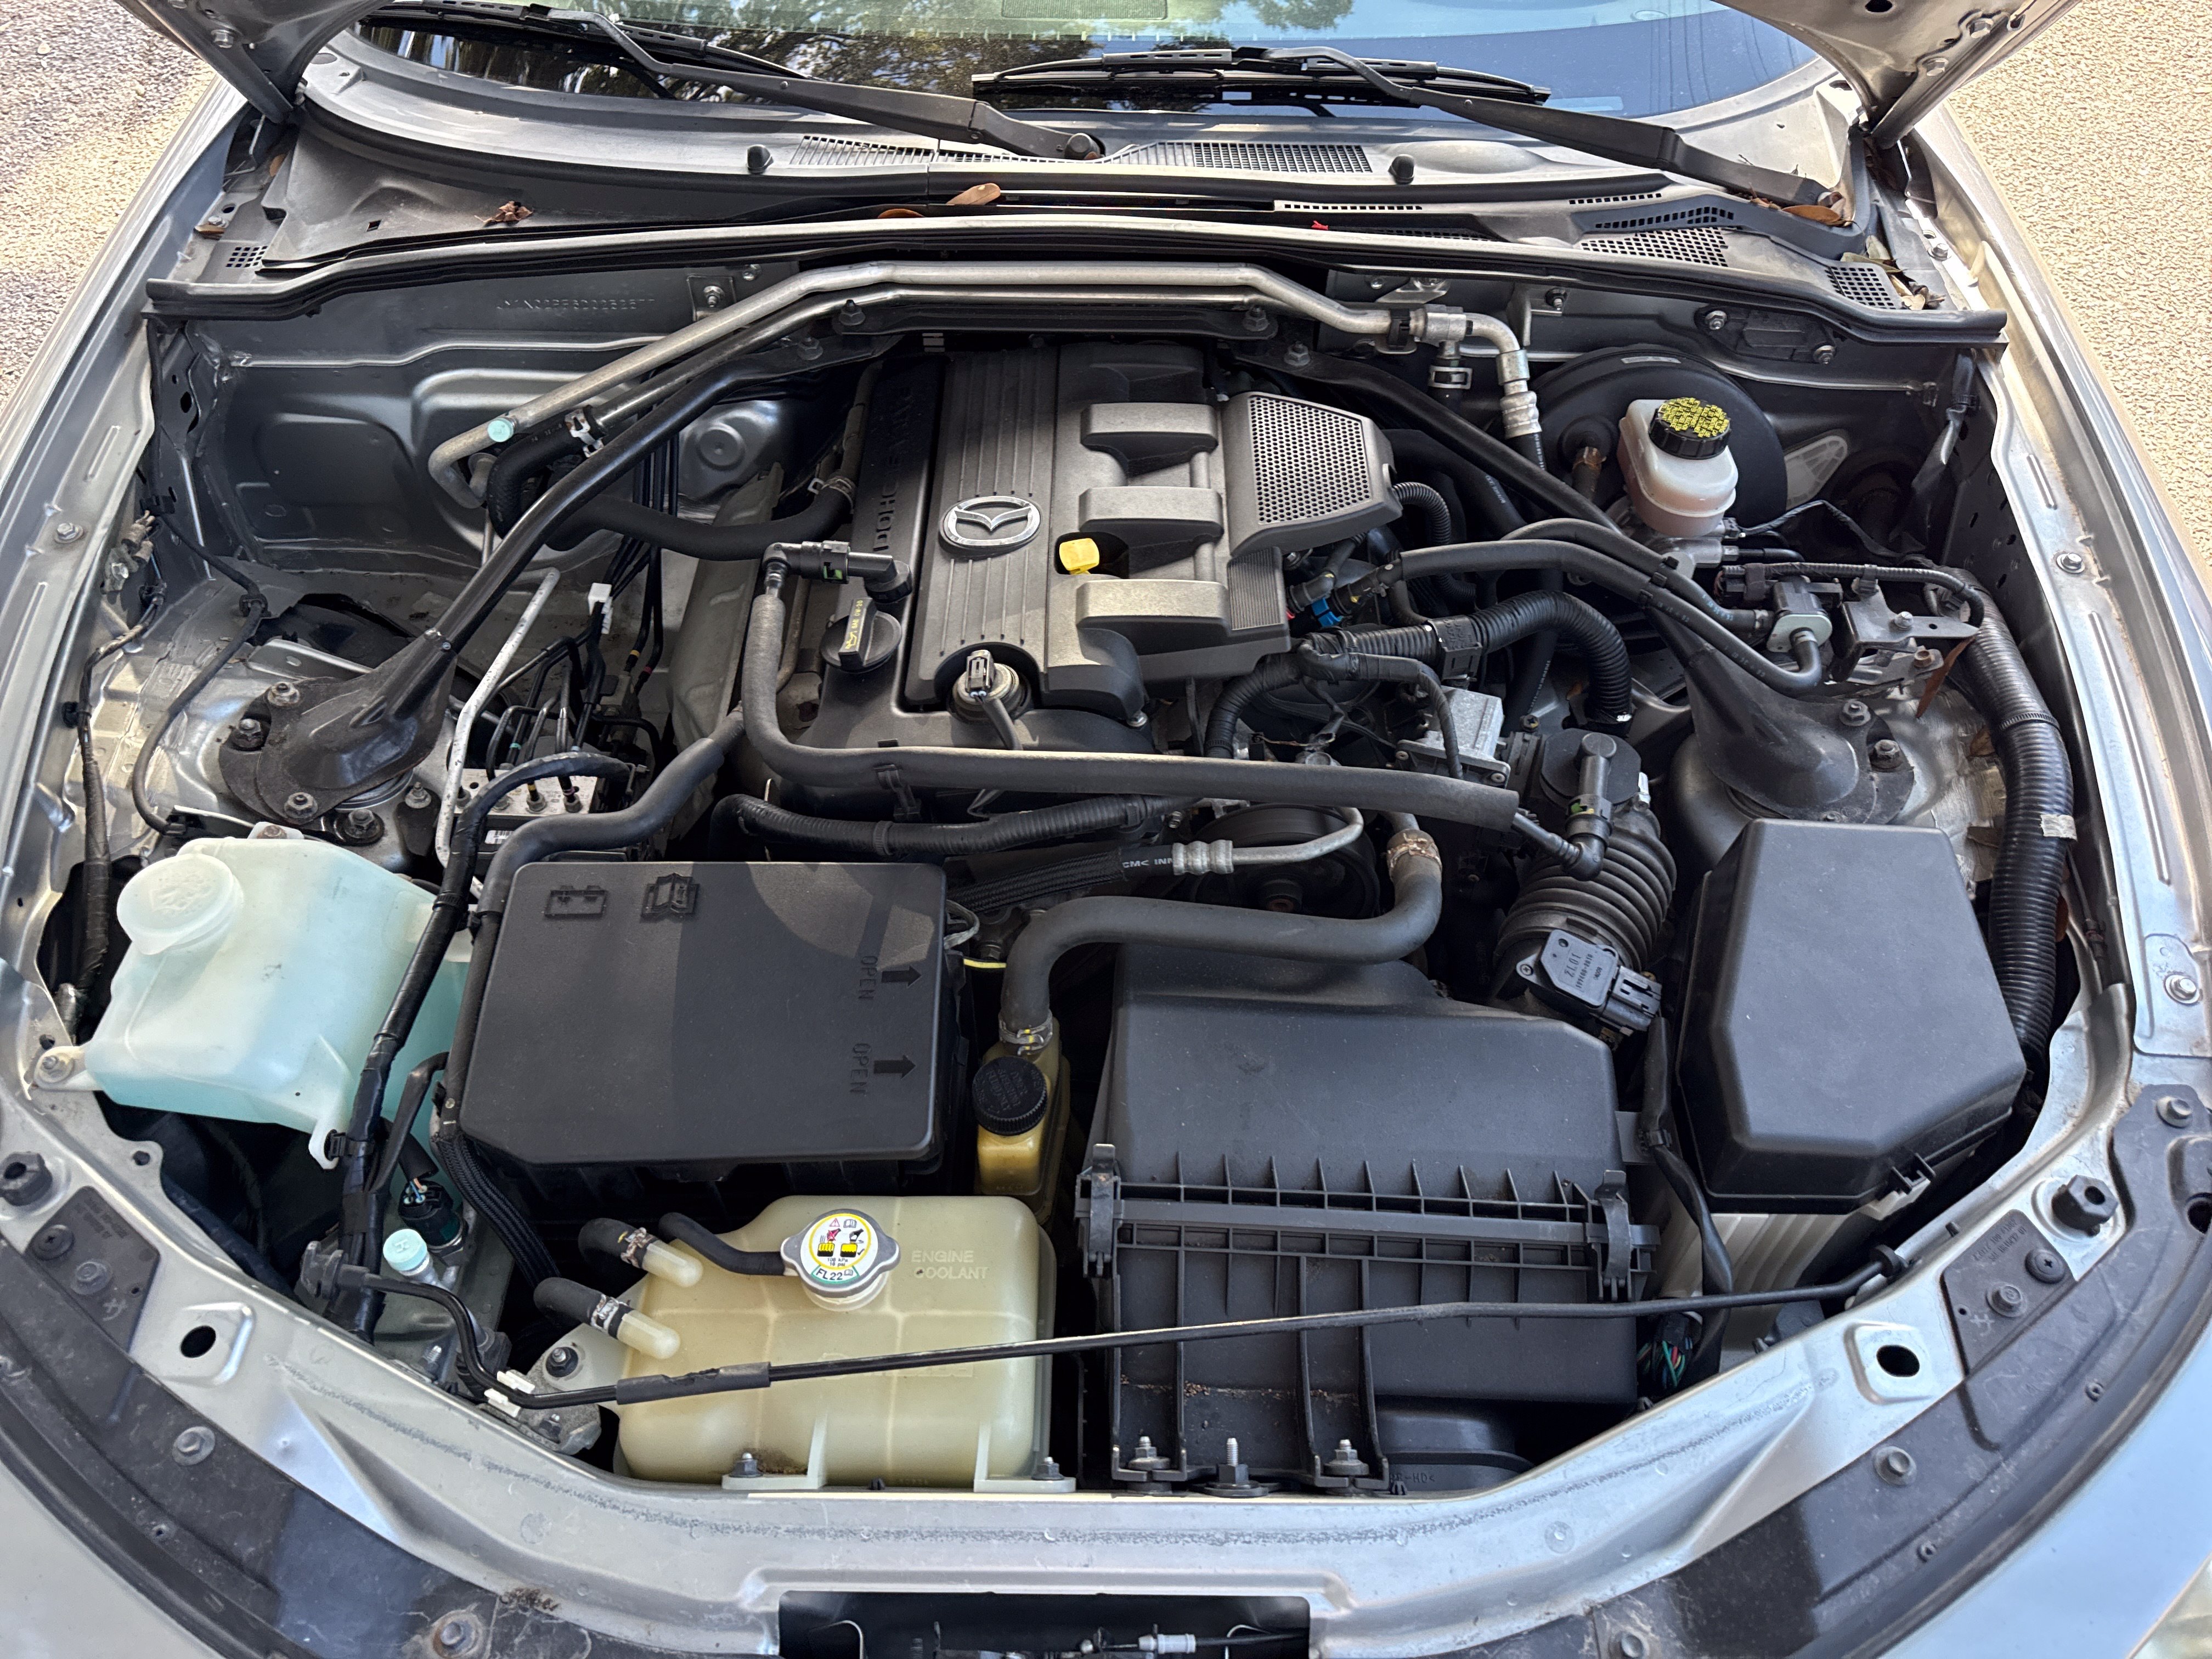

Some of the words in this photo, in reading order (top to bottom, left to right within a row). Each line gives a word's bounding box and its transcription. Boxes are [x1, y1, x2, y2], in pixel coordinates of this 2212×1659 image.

[854, 600, 864, 617] 0W-20
[857, 955, 878, 1000] OPEN
[850, 1043, 872, 1094] OPEN
[911, 1249, 974, 1263] ENGINE
[815, 1268, 843, 1280] FL22
[913, 1266, 989, 1279] COOLANT
